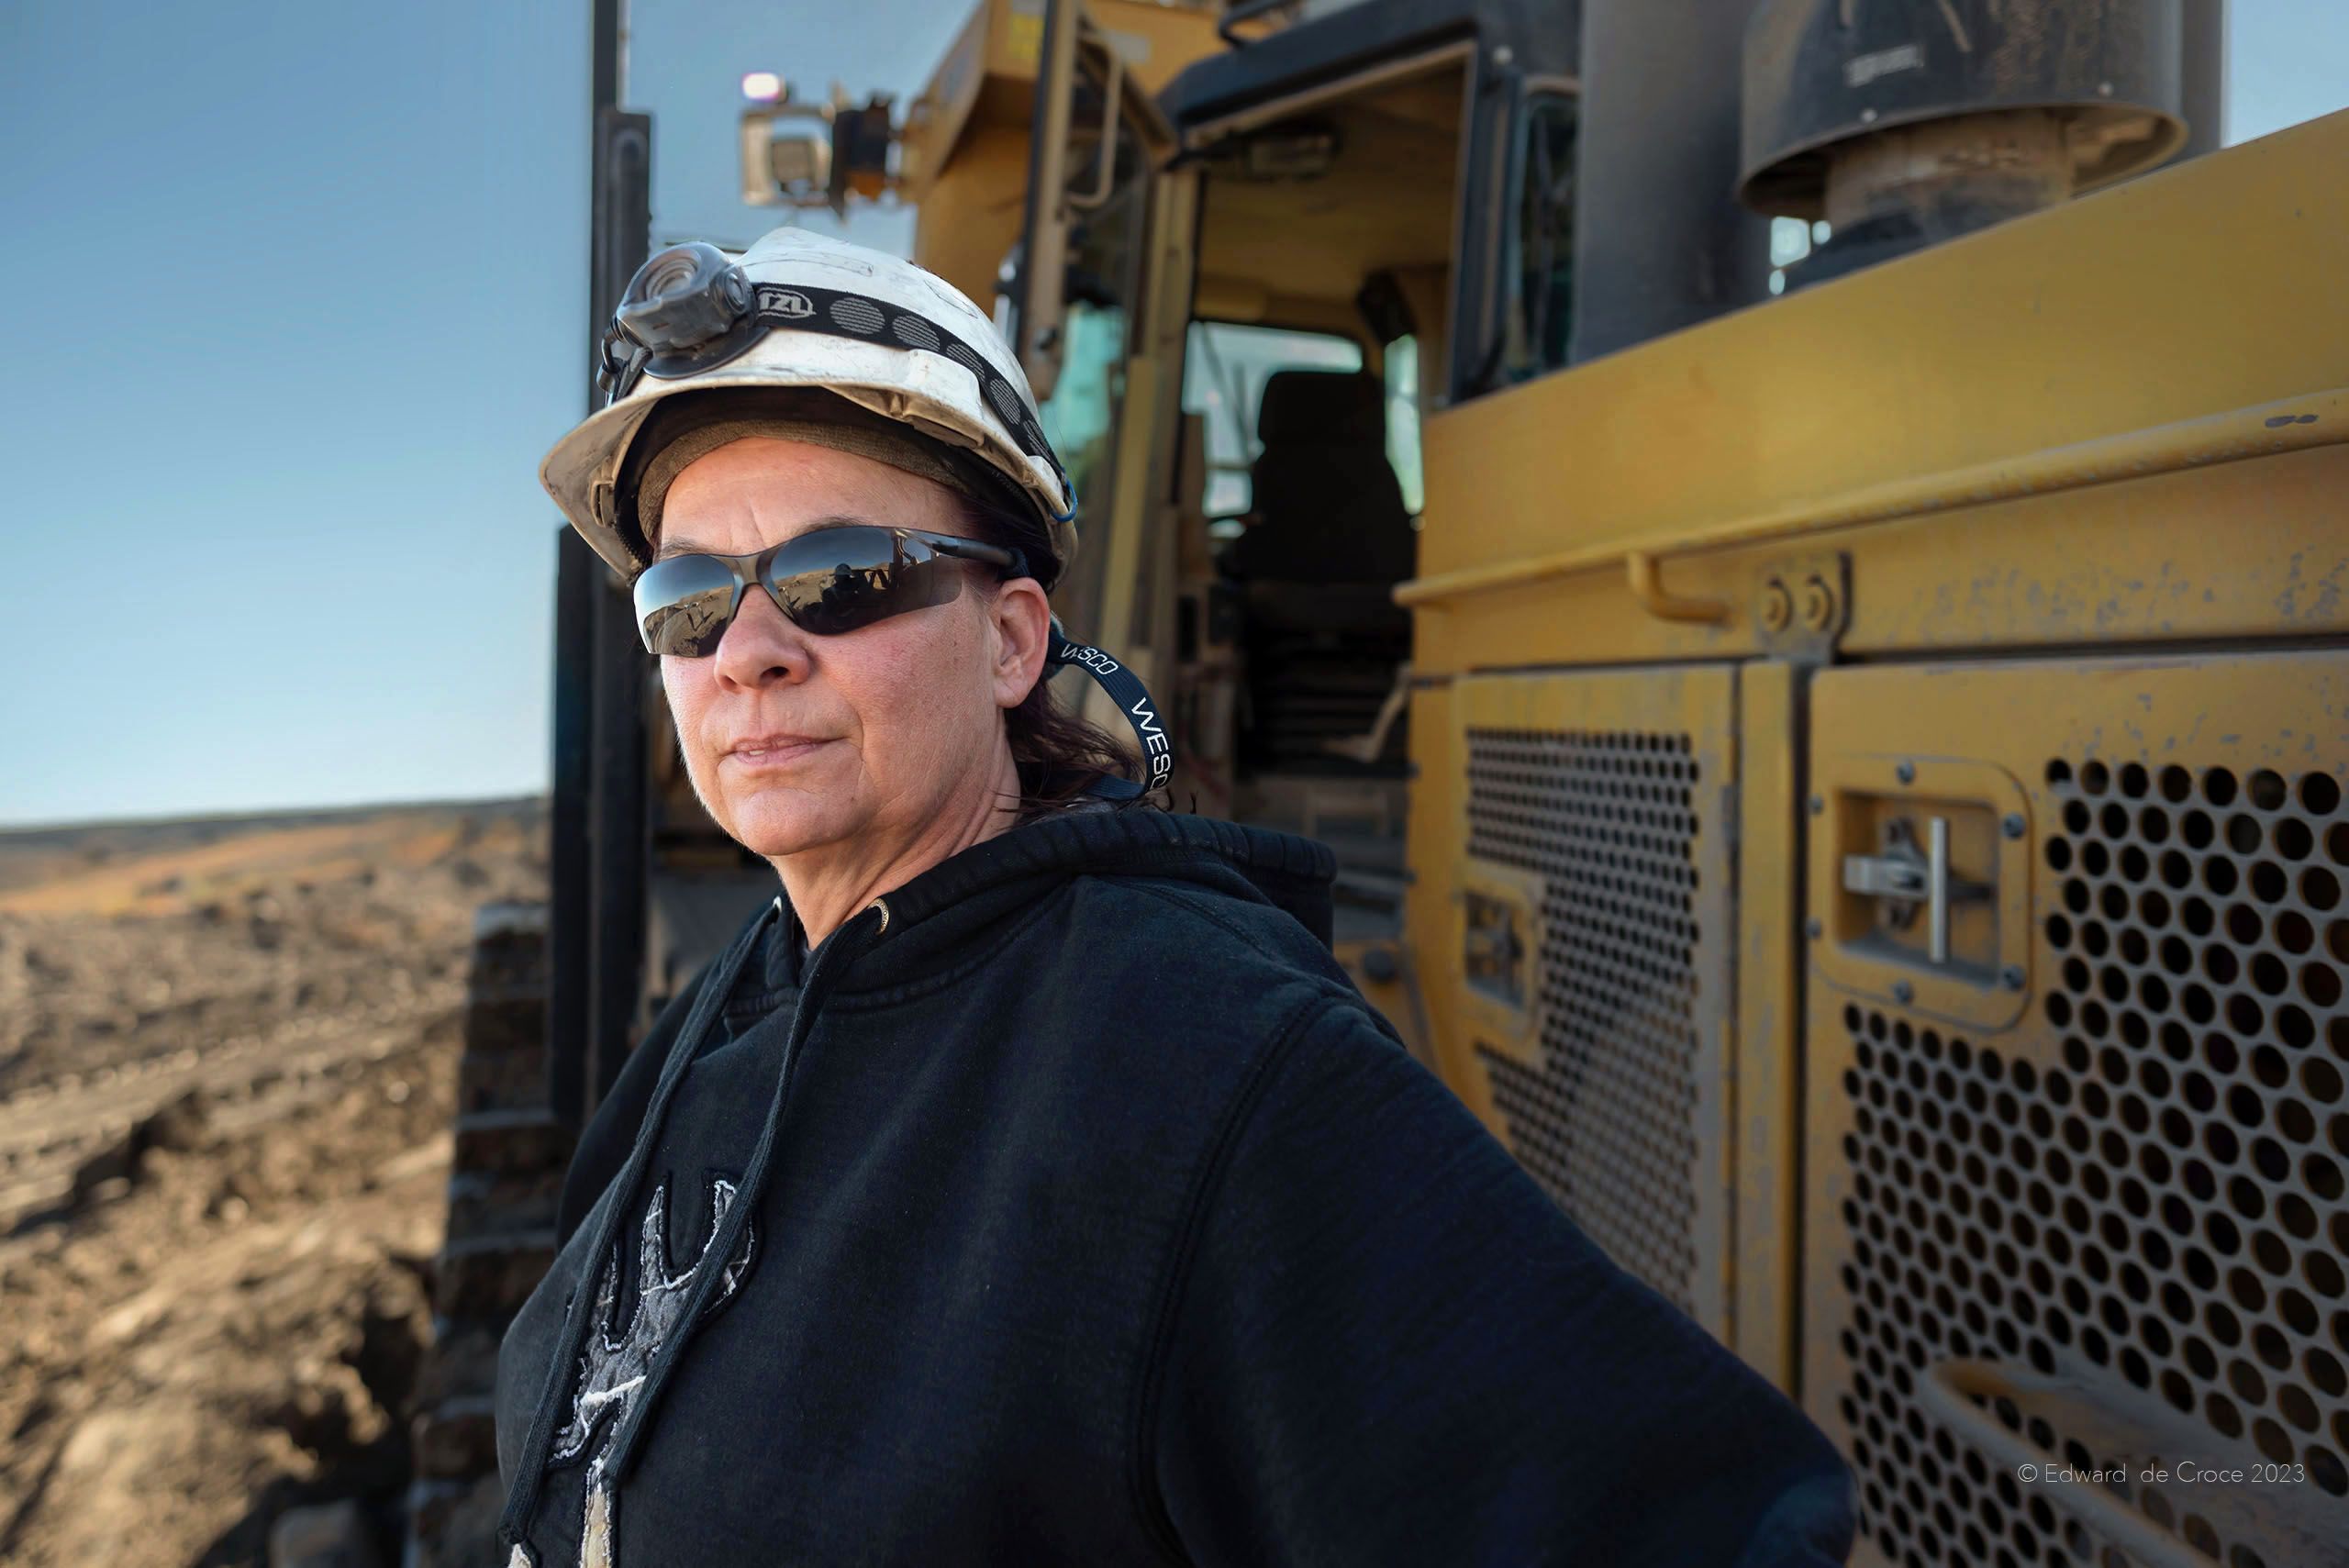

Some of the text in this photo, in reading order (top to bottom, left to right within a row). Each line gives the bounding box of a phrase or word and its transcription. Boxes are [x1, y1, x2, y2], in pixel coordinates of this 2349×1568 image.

[759, 291, 815, 316] TZL
[1061, 643, 1119, 675] WSCO
[1131, 697, 1171, 790] WESC
